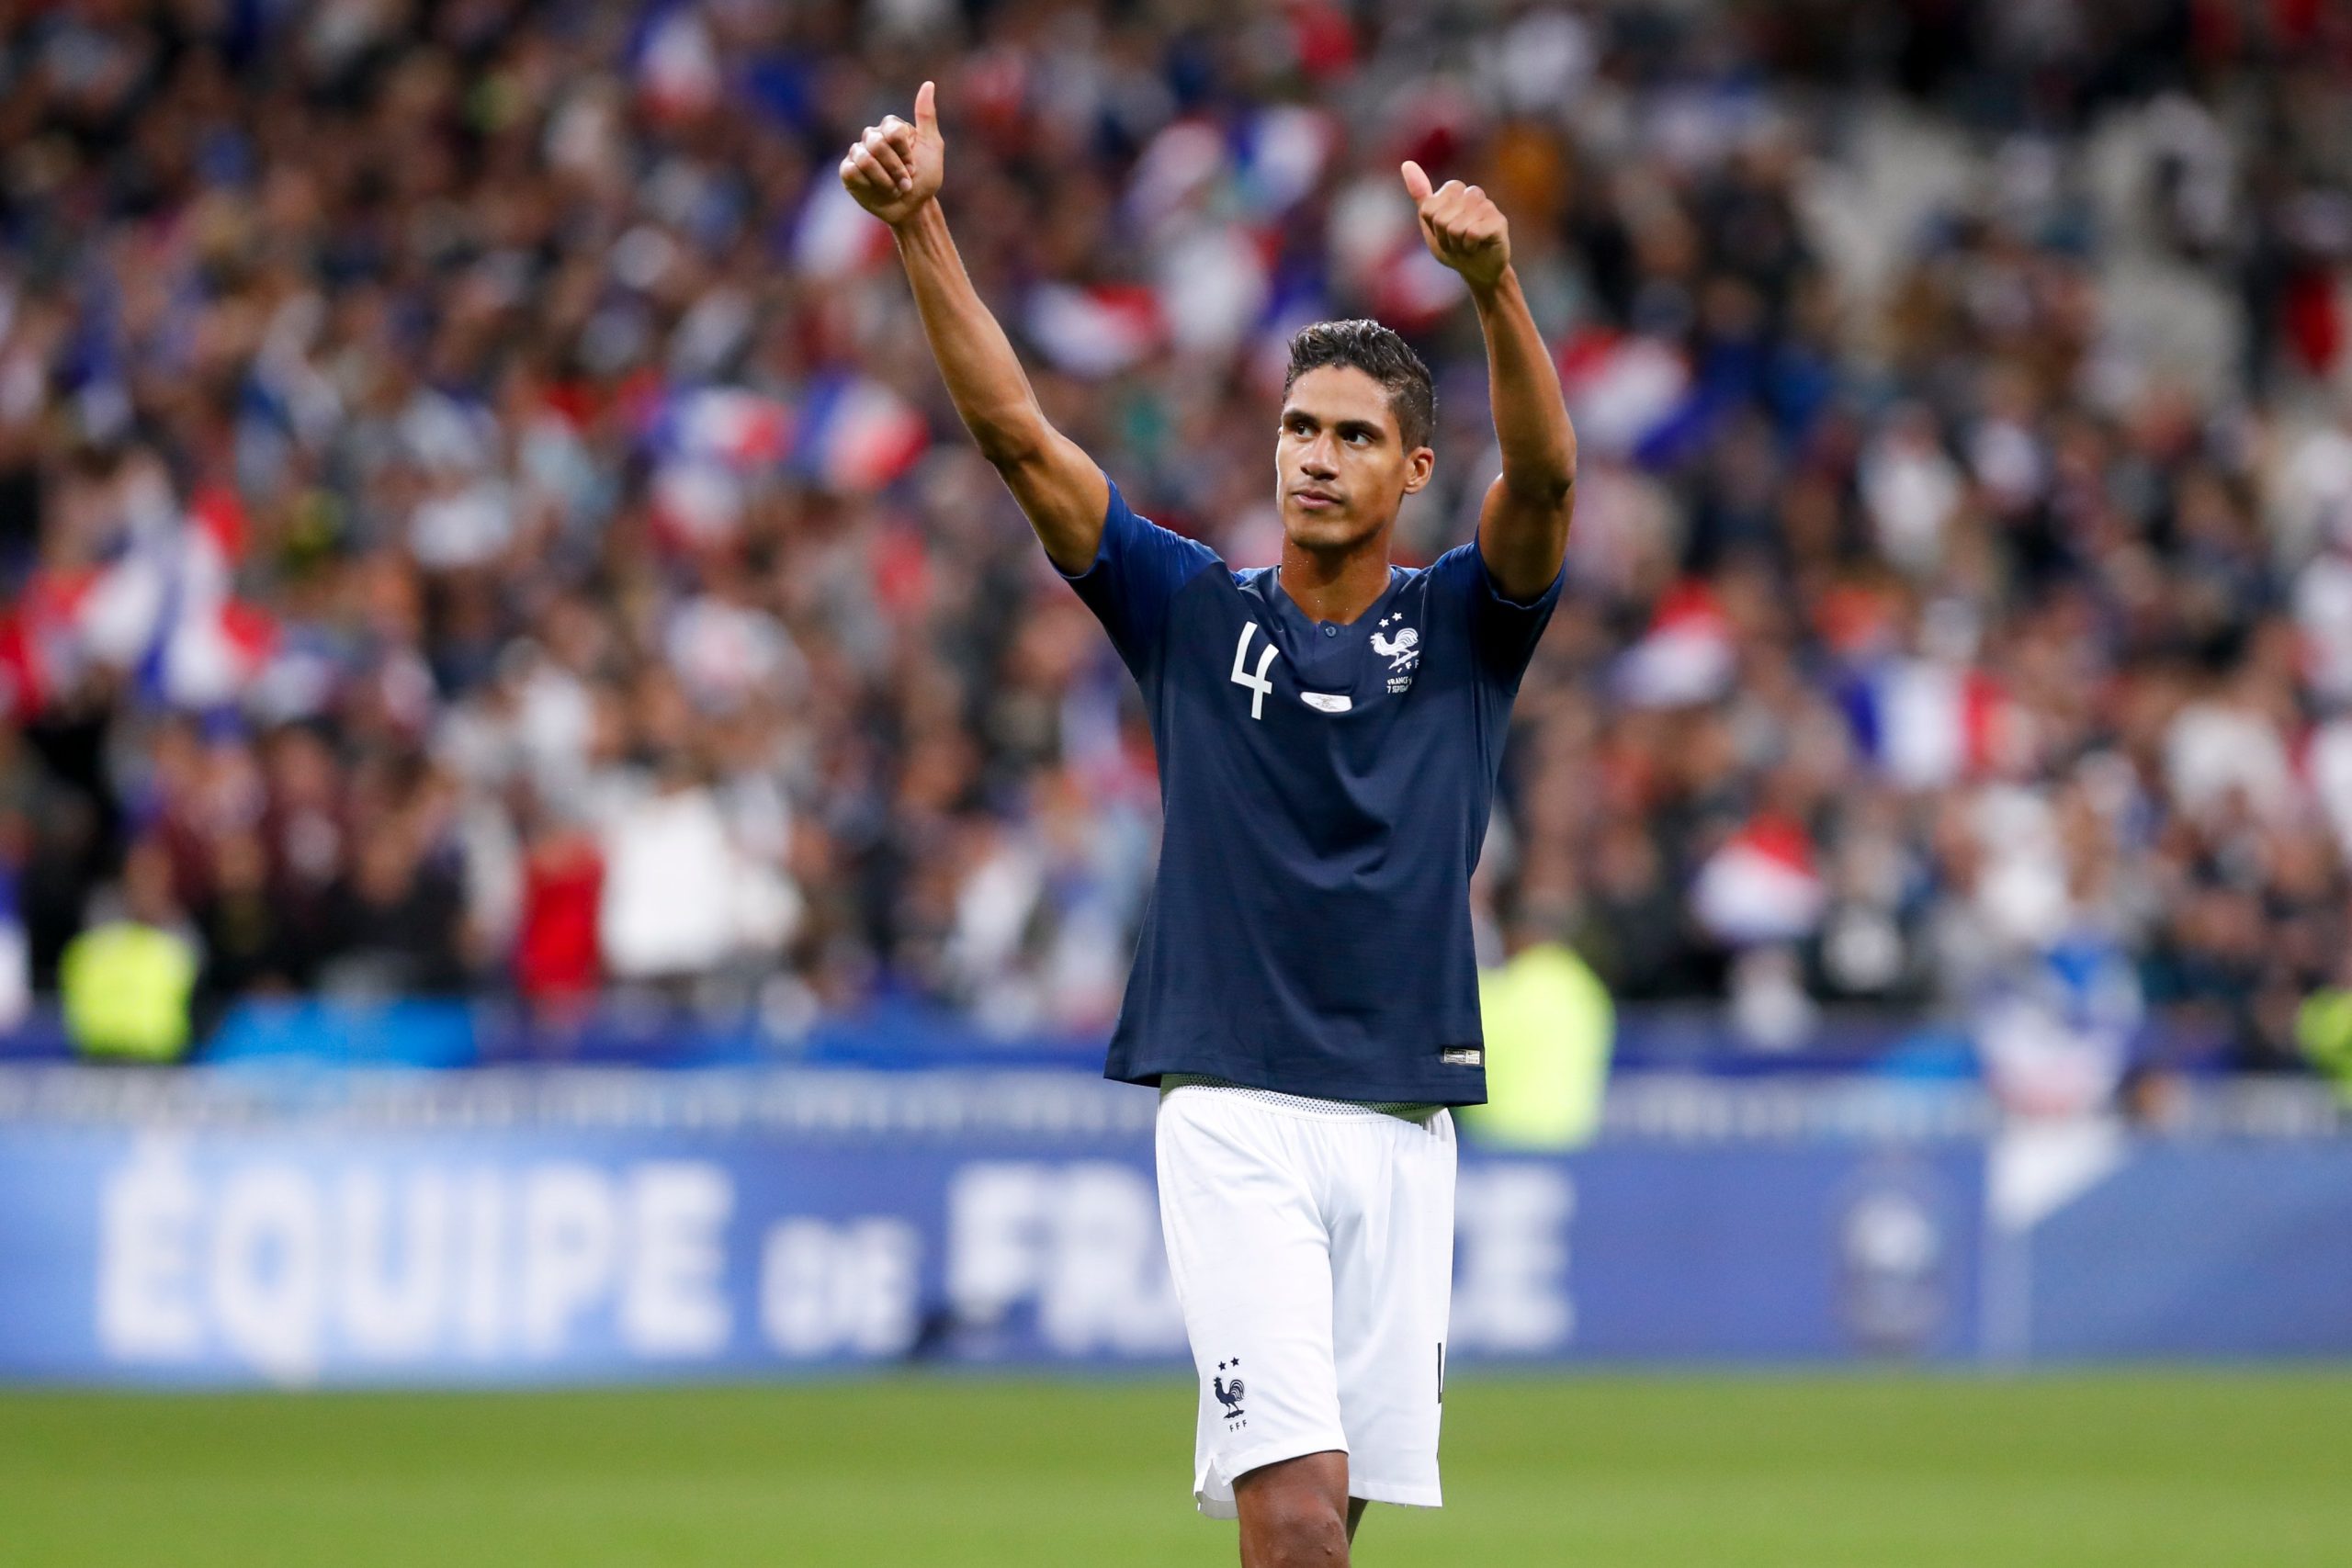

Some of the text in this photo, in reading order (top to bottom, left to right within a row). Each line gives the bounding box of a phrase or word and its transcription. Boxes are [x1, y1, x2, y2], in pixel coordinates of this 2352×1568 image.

[1230, 621, 1279, 720] 4
[99, 1128, 732, 1383] ÉQUIPE
[1229, 1419, 1248, 1433] FFF
